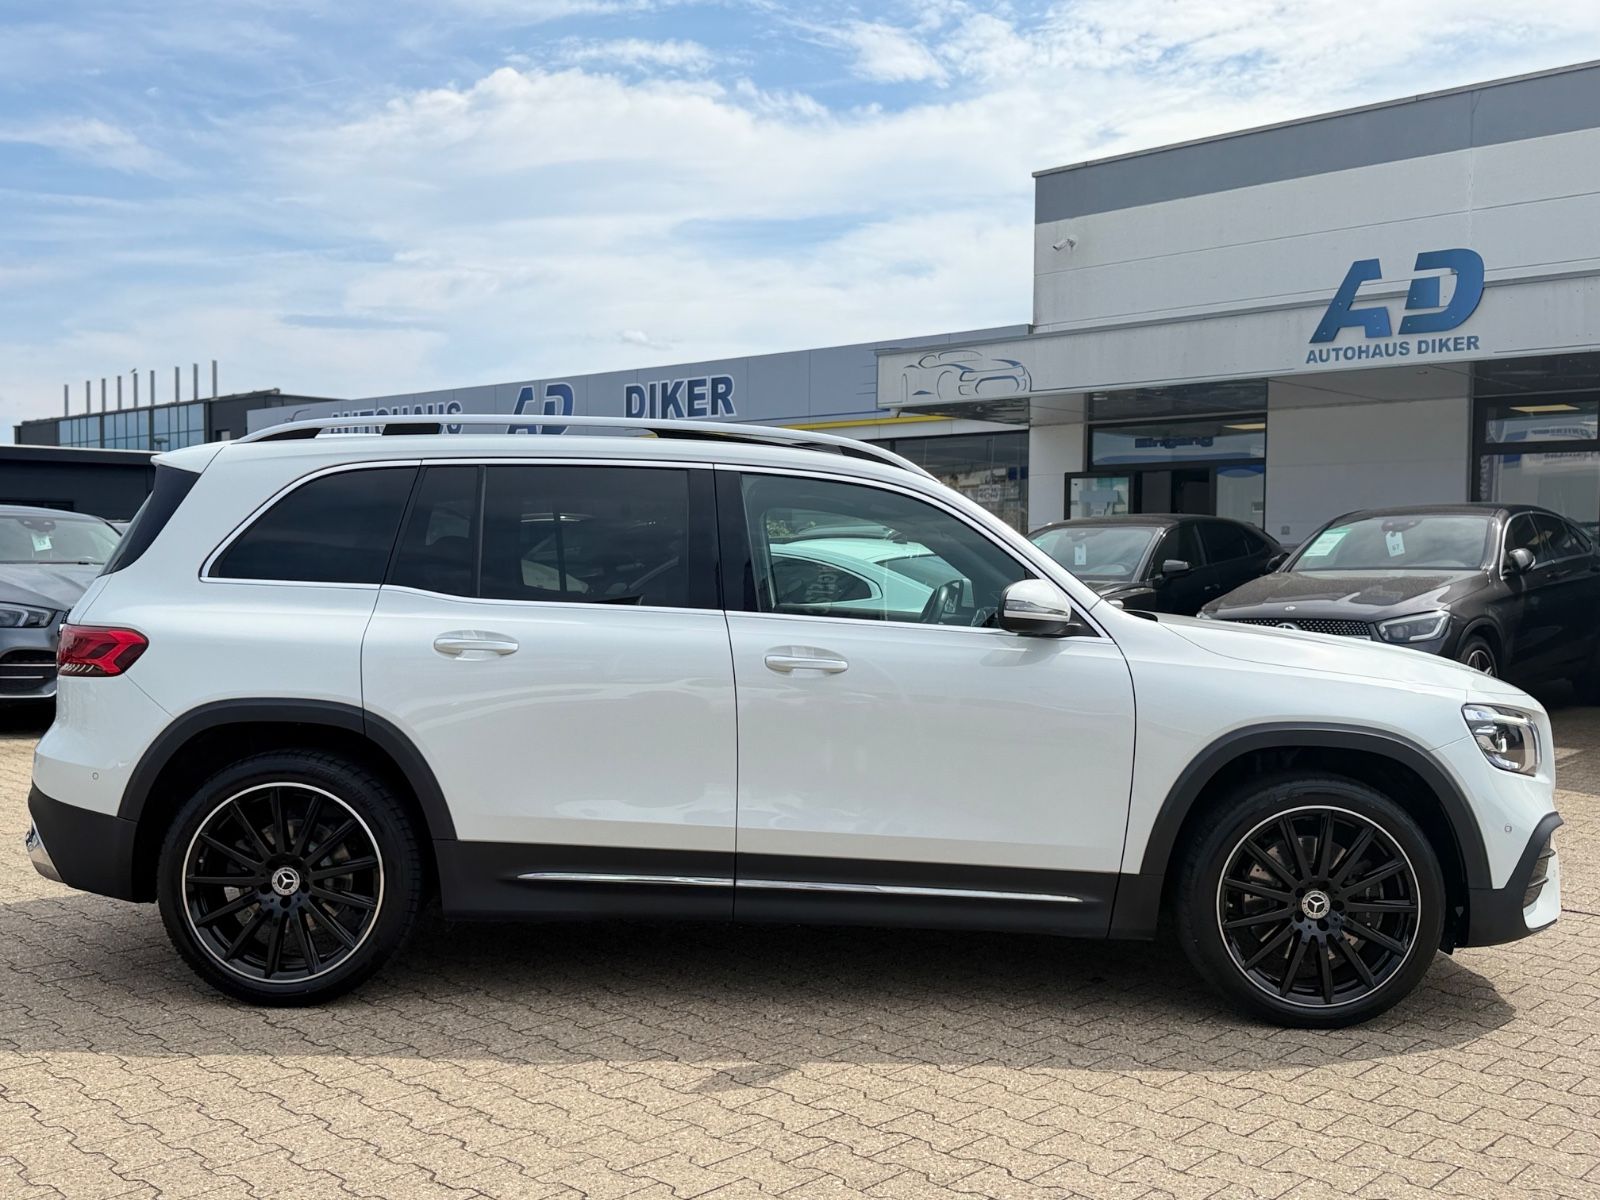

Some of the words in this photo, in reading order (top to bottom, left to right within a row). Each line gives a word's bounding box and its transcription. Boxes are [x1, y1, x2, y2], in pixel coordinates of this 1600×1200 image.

[1309, 248, 1485, 344] AD
[1305, 341, 1411, 364] AUTOHAUS
[1417, 335, 1480, 355] DIKER
[624, 374, 738, 419] DIKER
